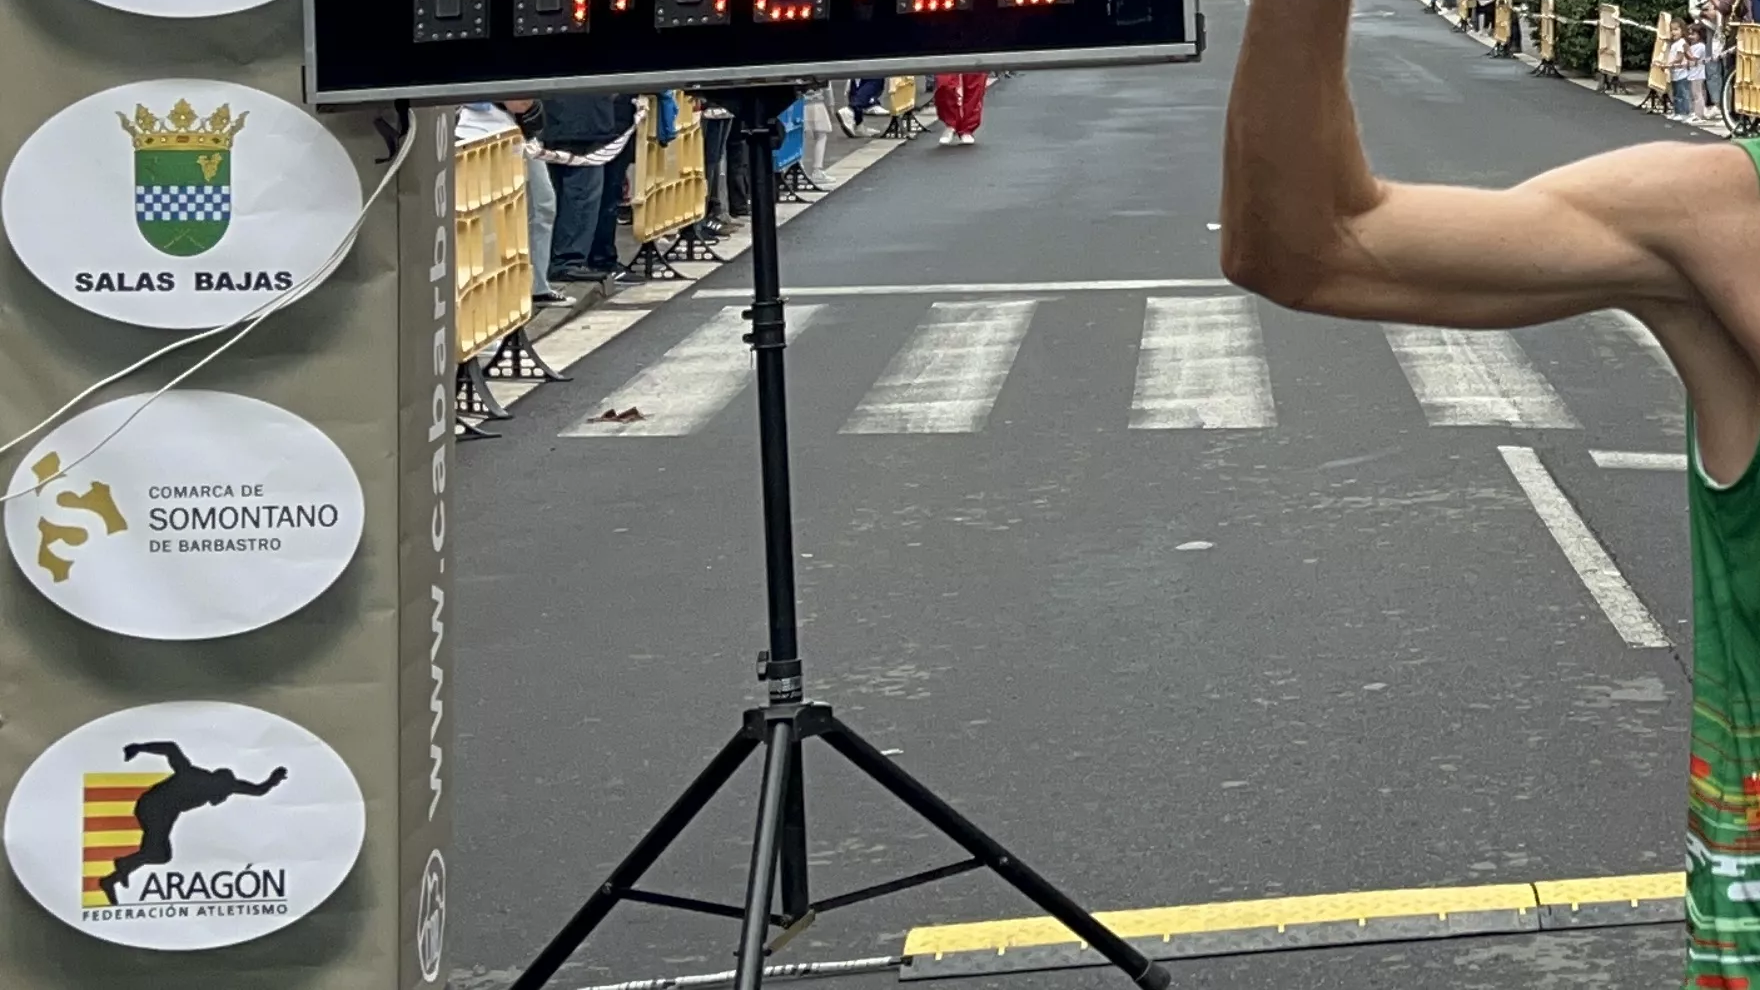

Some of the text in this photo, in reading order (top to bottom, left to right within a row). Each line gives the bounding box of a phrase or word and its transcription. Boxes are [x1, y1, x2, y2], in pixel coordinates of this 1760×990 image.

[74, 270, 293, 293] SALAS BAJAS
[148, 484, 264, 500] COMARCA DE
[148, 503, 340, 532] SOMONTANO
[149, 537, 282, 554] DE BARBASTRO
[138, 863, 287, 901] ARAGÓN
[82, 902, 288, 922] FEDERACIÓN ATLETISMO
